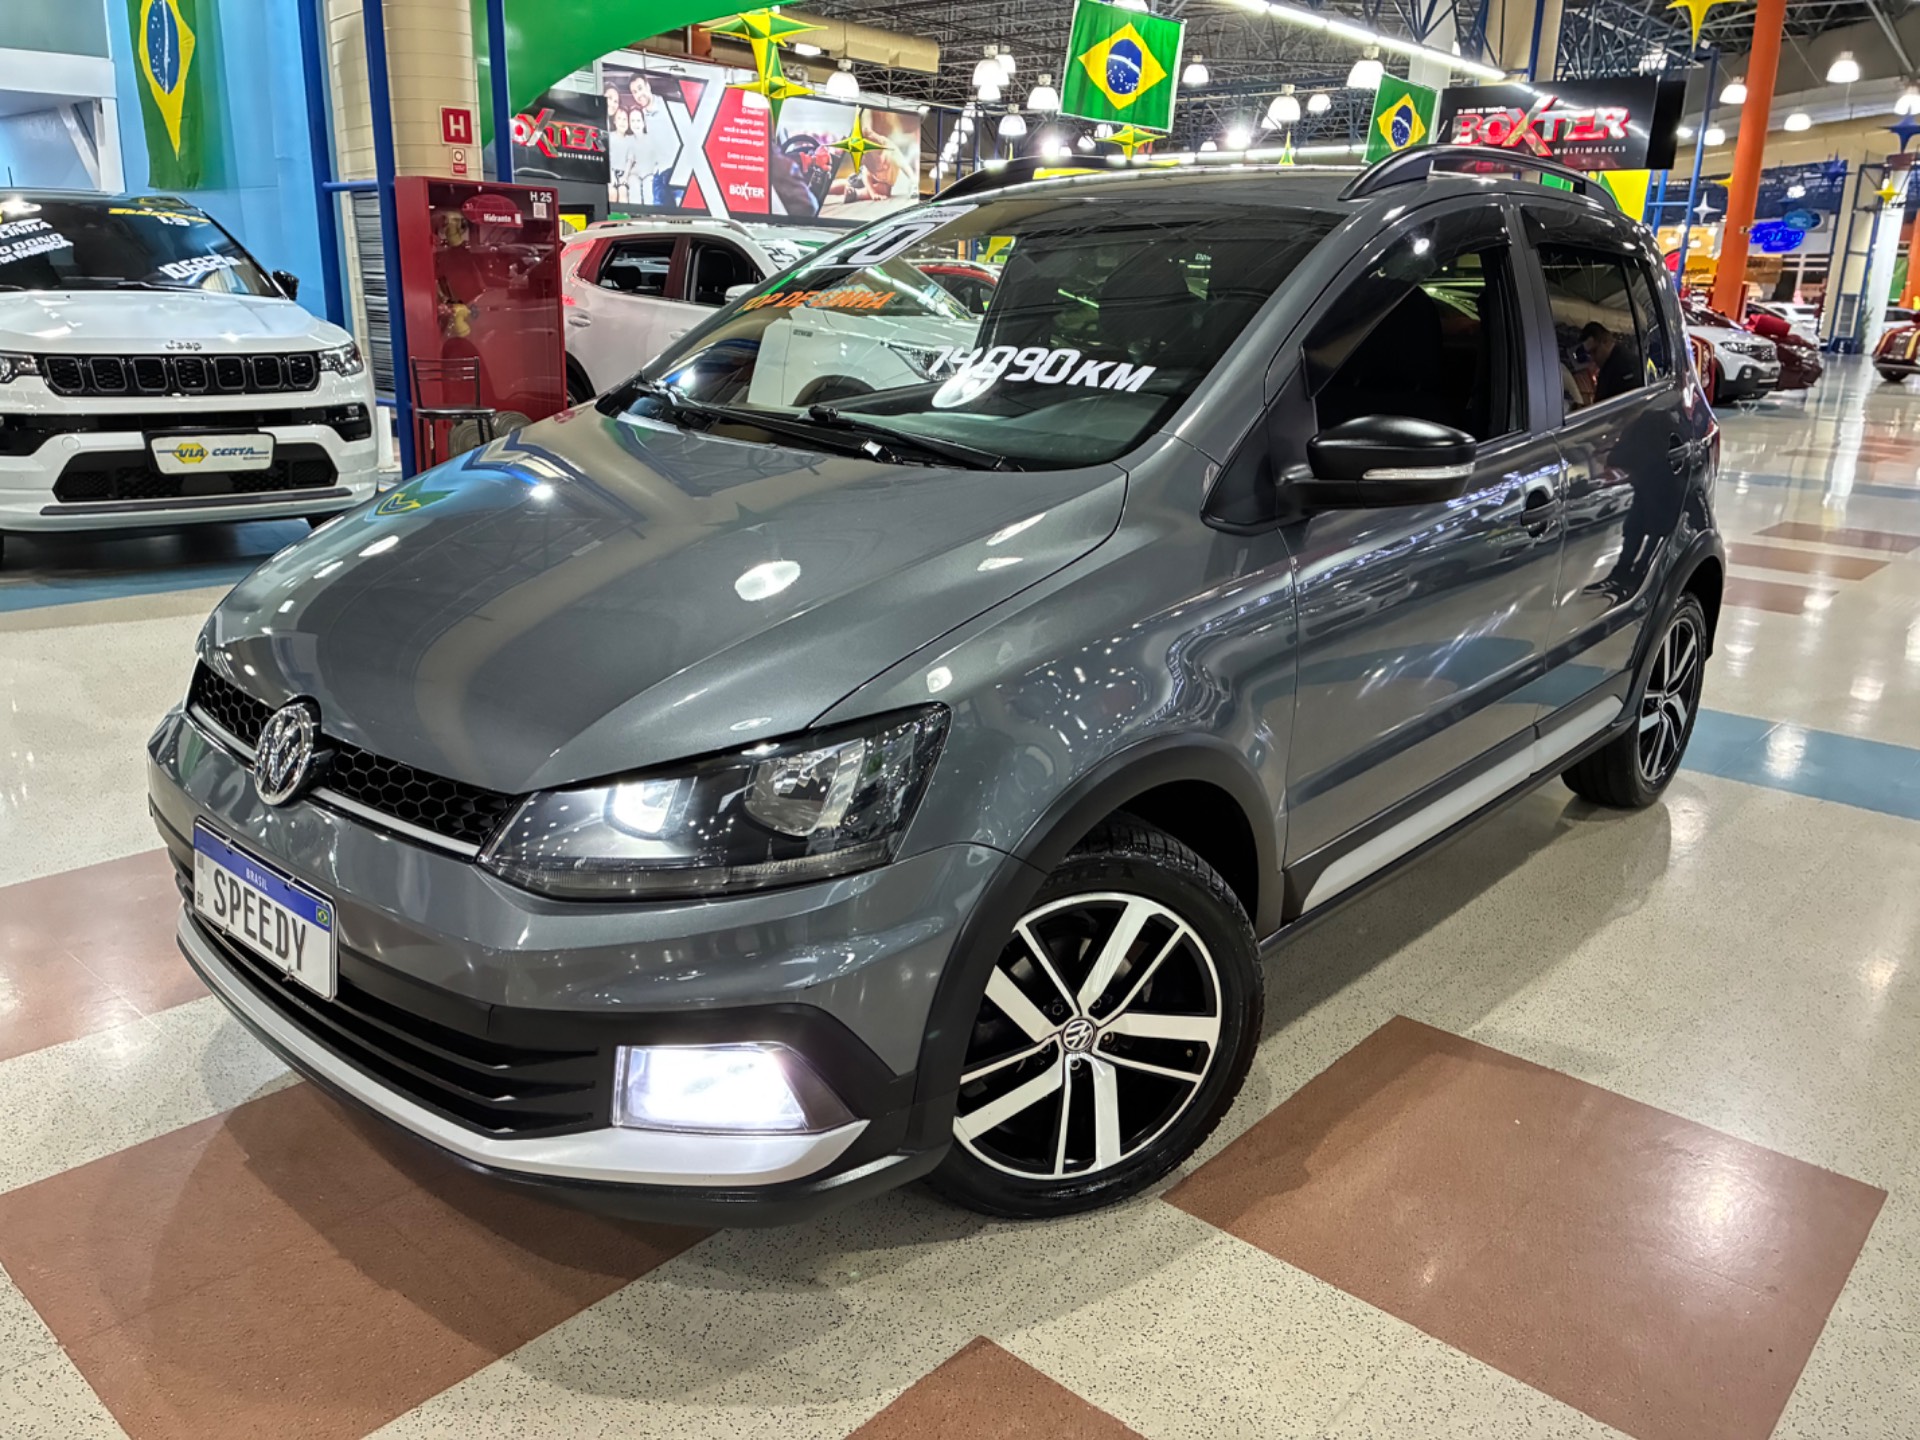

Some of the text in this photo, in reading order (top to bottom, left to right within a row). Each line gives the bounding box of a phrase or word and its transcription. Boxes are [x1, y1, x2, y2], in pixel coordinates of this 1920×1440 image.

[448, 114, 466, 138] H
[511, 108, 607, 157] OXTER
[1452, 95, 1631, 156] BOXTER
[1553, 145, 1627, 155] MULTIMARCAS
[530, 191, 553, 204] H 25
[729, 182, 765, 200] BOXTER
[483, 213, 512, 223] Hidrante
[165, 340, 202, 351] Jeep
[178, 446, 255, 458] VIA CERTA
[245, 867, 269, 891] BRASIL
[213, 867, 306, 971] SPEEDY
